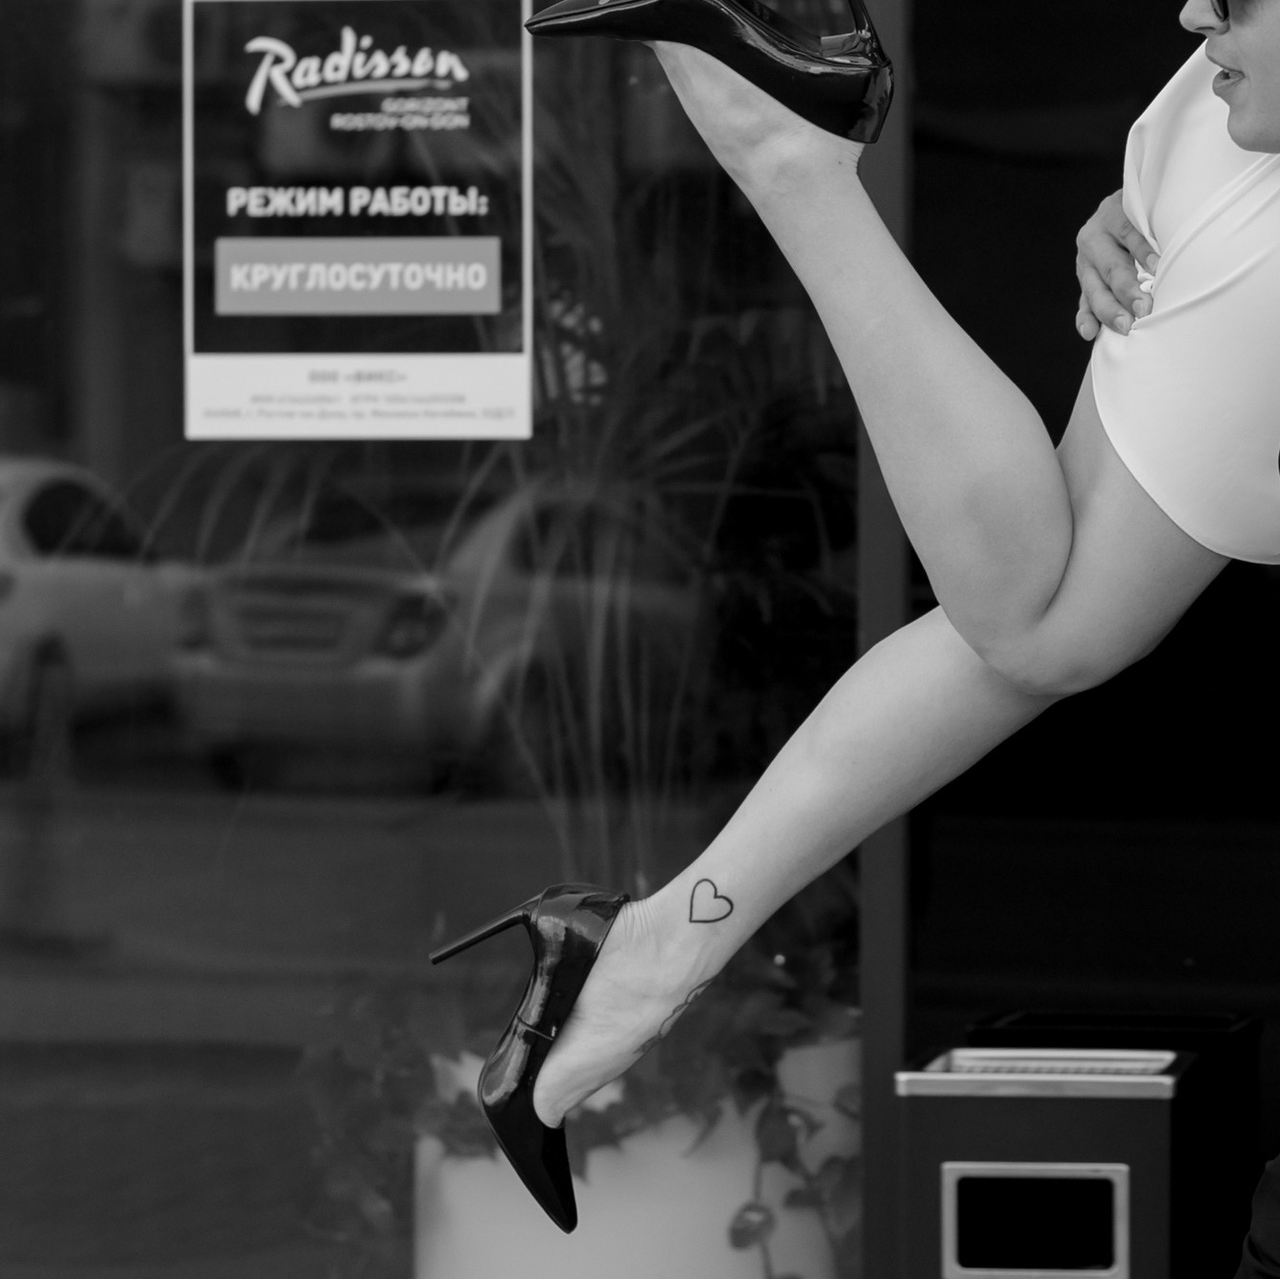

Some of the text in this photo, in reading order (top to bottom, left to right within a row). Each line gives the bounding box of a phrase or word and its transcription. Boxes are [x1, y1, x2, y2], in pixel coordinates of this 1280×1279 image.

[244, 25, 469, 115] Radisson
[226, 187, 489, 217] РЕЖИМ РАБОТЫ:
[230, 263, 488, 291] КРУГЛОСУТОЧНО
